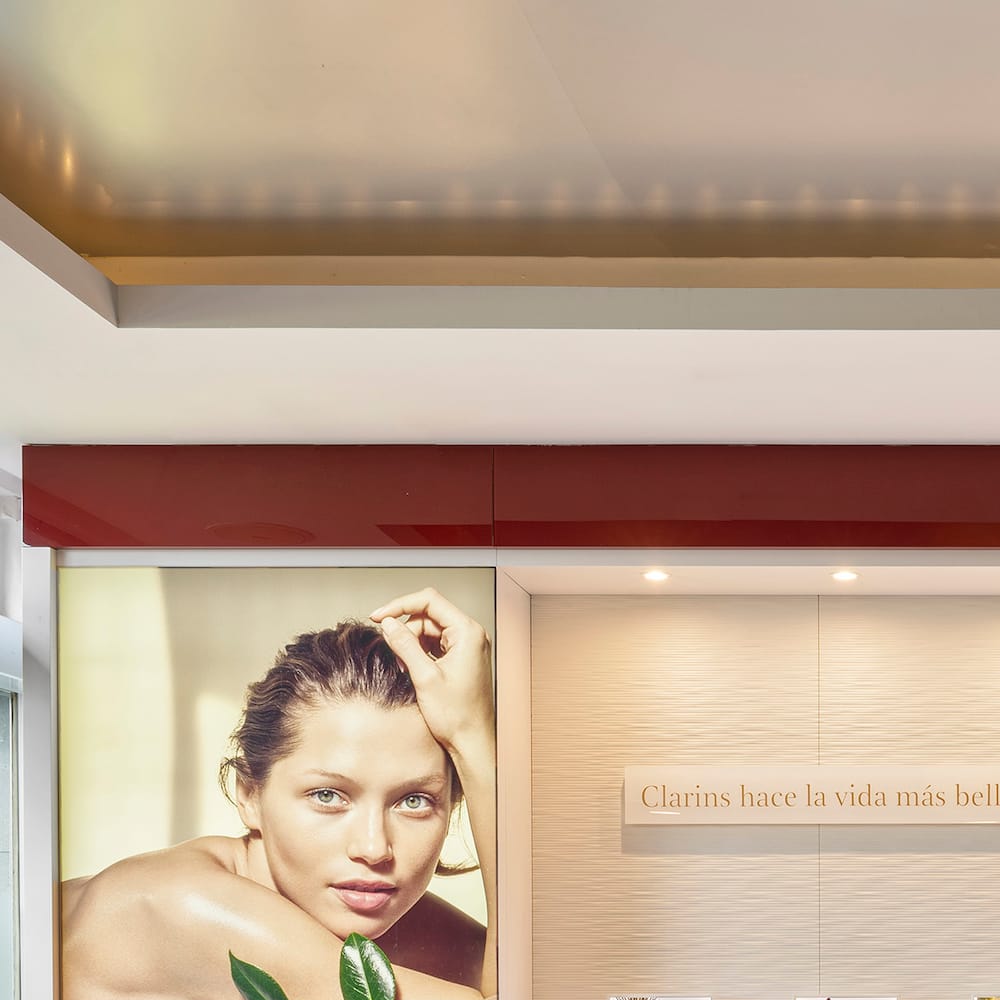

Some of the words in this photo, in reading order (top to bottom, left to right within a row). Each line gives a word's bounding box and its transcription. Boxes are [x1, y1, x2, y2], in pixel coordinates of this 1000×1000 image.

[640, 783, 731, 809] Clarins
[739, 783, 798, 809] hace
[806, 783, 828, 808] la
[835, 783, 888, 808] vida
[896, 784, 947, 808] más
